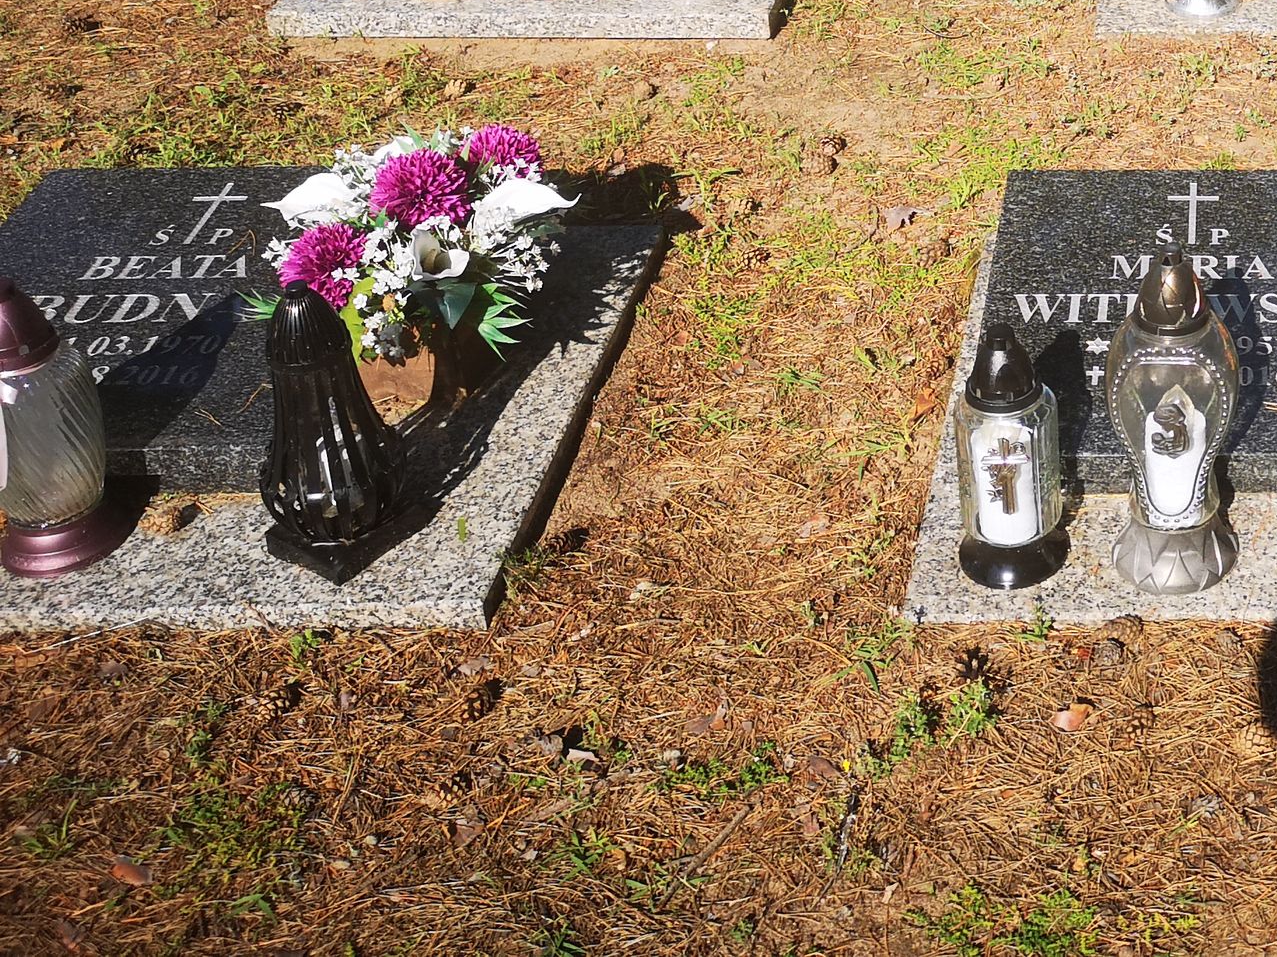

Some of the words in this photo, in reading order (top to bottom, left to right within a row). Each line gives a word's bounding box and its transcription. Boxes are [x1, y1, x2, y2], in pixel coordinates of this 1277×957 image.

[204, 228, 234, 245] P
[1155, 224, 1173, 245] Ś
[1211, 228, 1230, 245] P
[78, 255, 250, 281] BEATA
[1109, 255, 1274, 280] MRIA
[31, 293, 218, 324] BUDN
